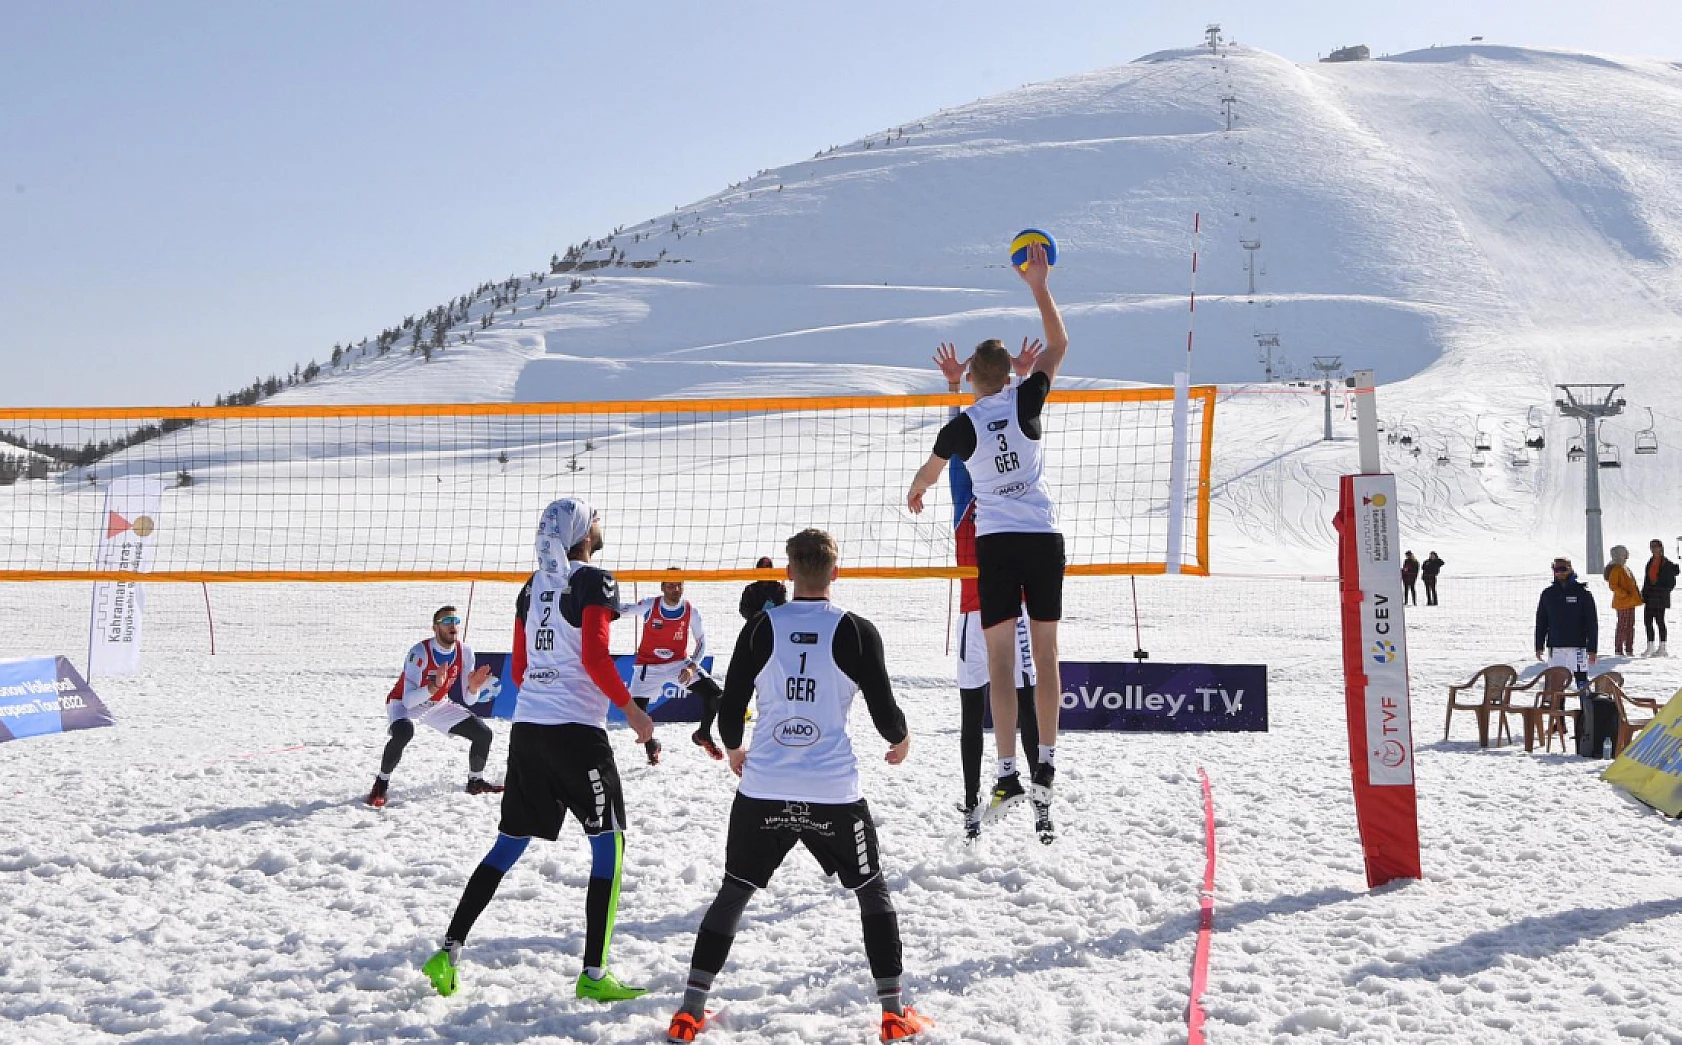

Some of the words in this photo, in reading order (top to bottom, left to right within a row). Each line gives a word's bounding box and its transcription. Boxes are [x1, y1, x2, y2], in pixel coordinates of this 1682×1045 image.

[998, 434, 1008, 451] 3
[995, 452, 1020, 473] GER
[108, 541, 132, 642] Kahramanaraş
[541, 607, 551, 626] 2
[1374, 594, 1390, 635] CEV
[535, 629, 554, 651] GER
[799, 651, 807, 674] 1
[785, 677, 816, 703] GER
[1059, 685, 1244, 716] oVolley.TV
[1381, 697, 1397, 736] TVF
[782, 724, 814, 737] MADO
